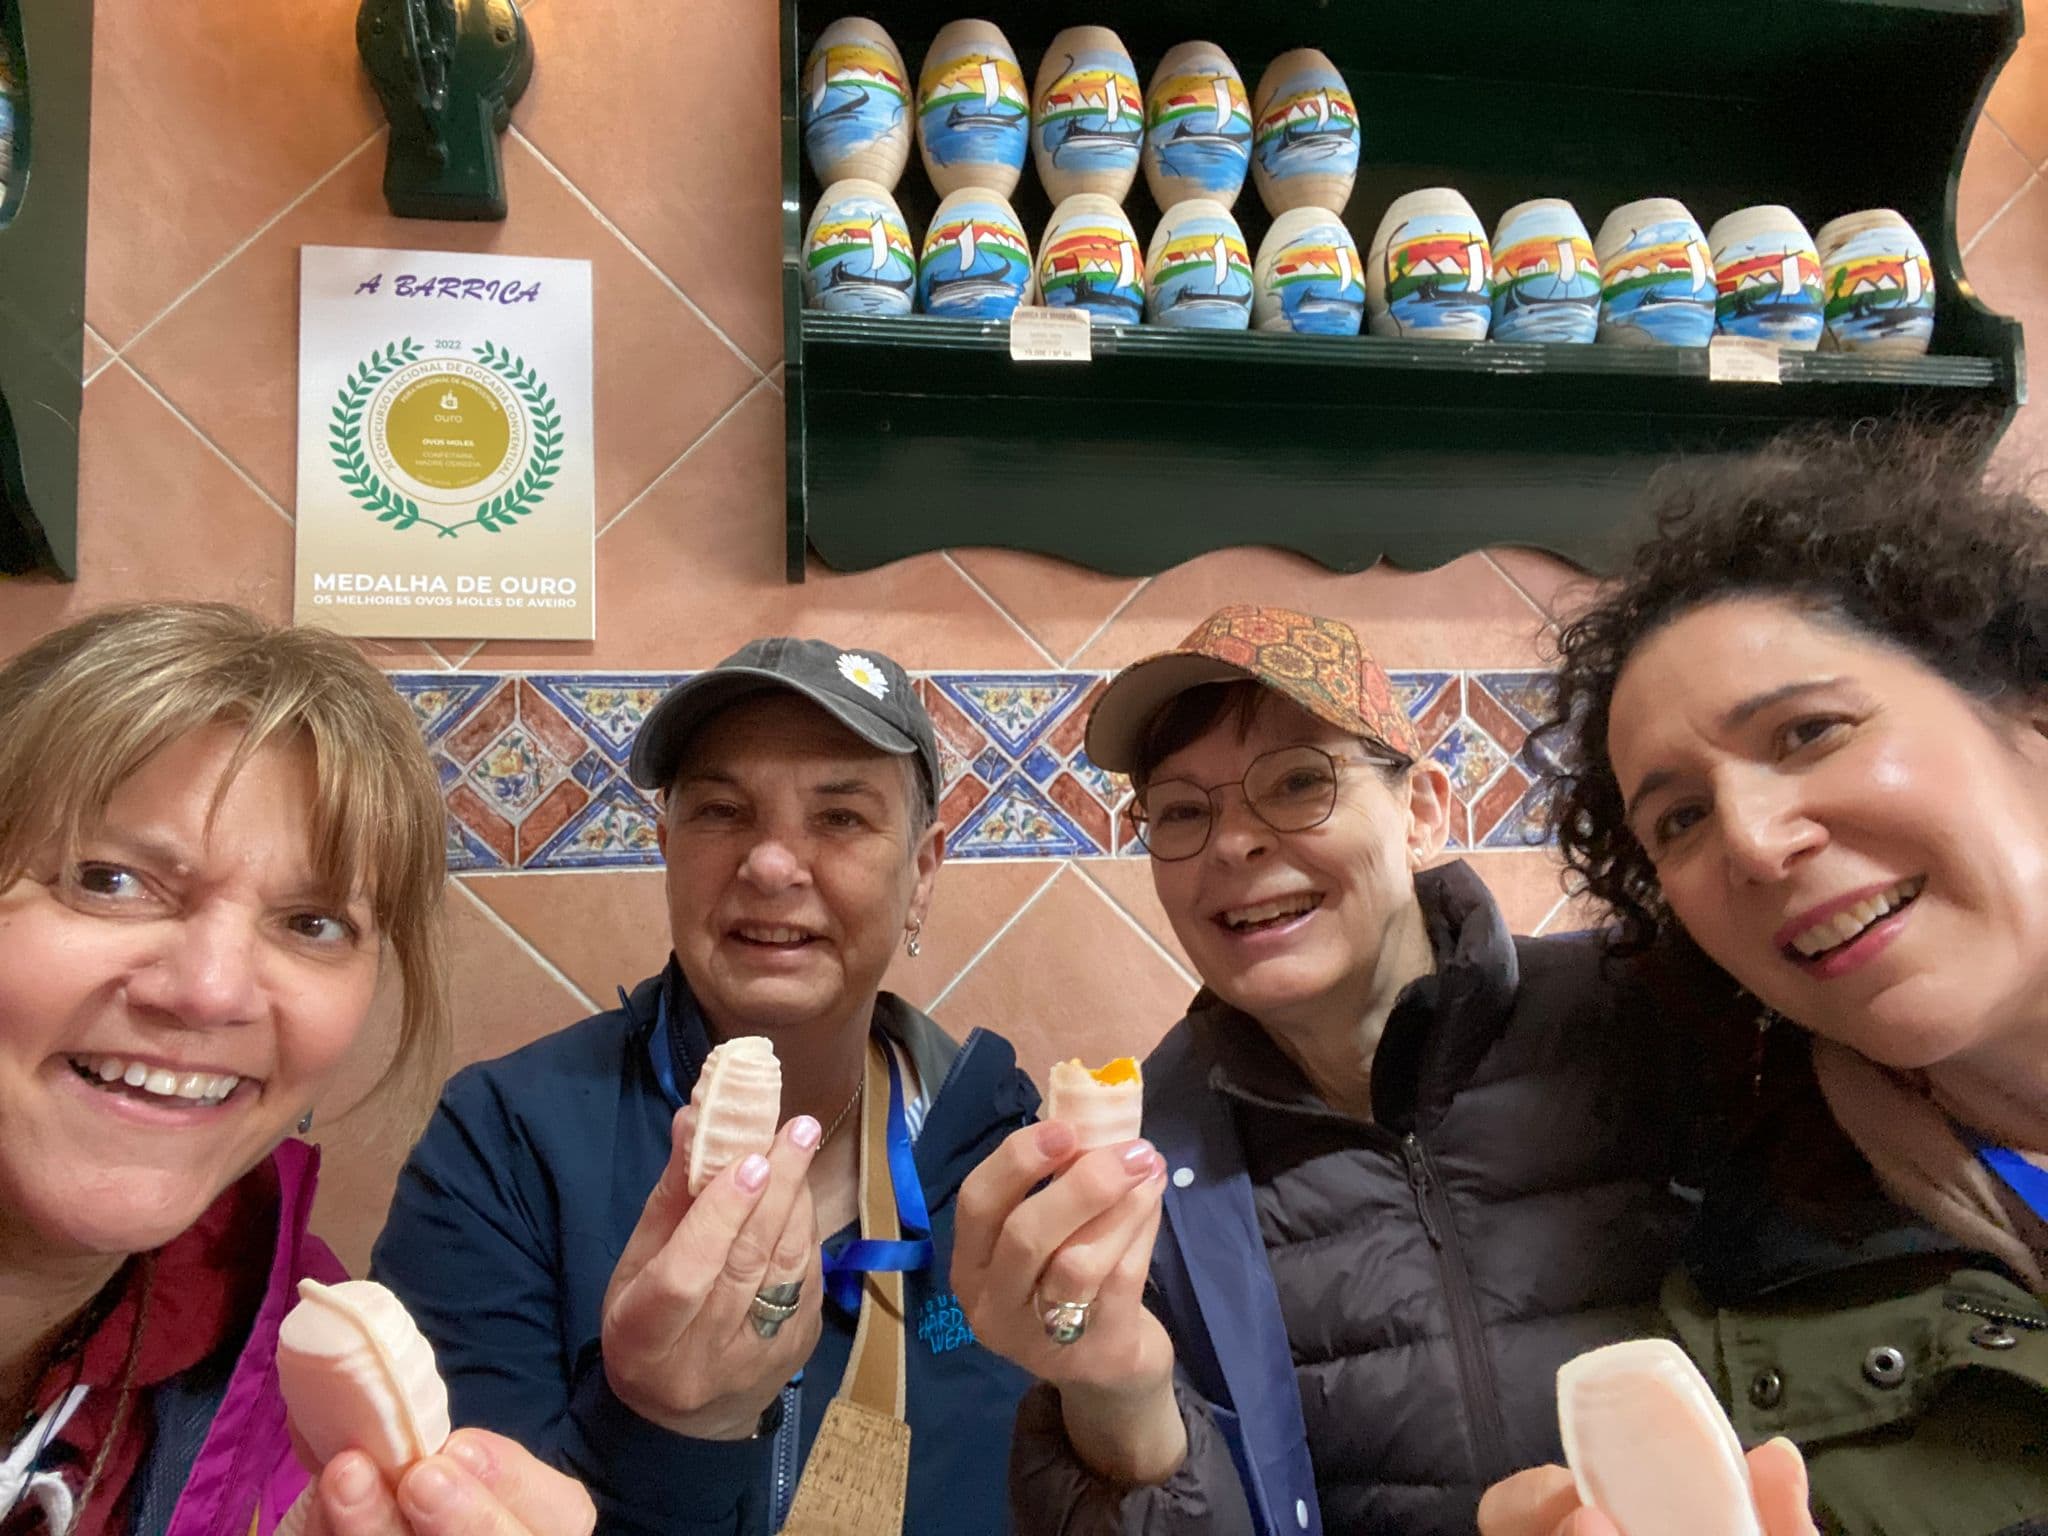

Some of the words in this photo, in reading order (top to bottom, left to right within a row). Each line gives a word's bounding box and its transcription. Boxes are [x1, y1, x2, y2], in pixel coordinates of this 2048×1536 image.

[355, 273, 383, 295] A
[394, 274, 542, 305] BARRICA
[434, 339, 462, 350] 2022
[374, 394, 392, 460] CONCURSO
[388, 362, 443, 395] NACIONAL
[446, 362, 462, 372] DE
[499, 403, 521, 477] CONVENTUAL
[313, 573, 448, 593] MEDALHA
[456, 576, 493, 594] DE
[500, 577, 577, 595] OURO
[313, 595, 333, 606] OS
[336, 595, 411, 607] MELHORES
[415, 596, 453, 607] OVOS
[456, 597, 502, 608] MOLES
[505, 598, 524, 608] DE
[527, 598, 577, 609] AVEIRO
